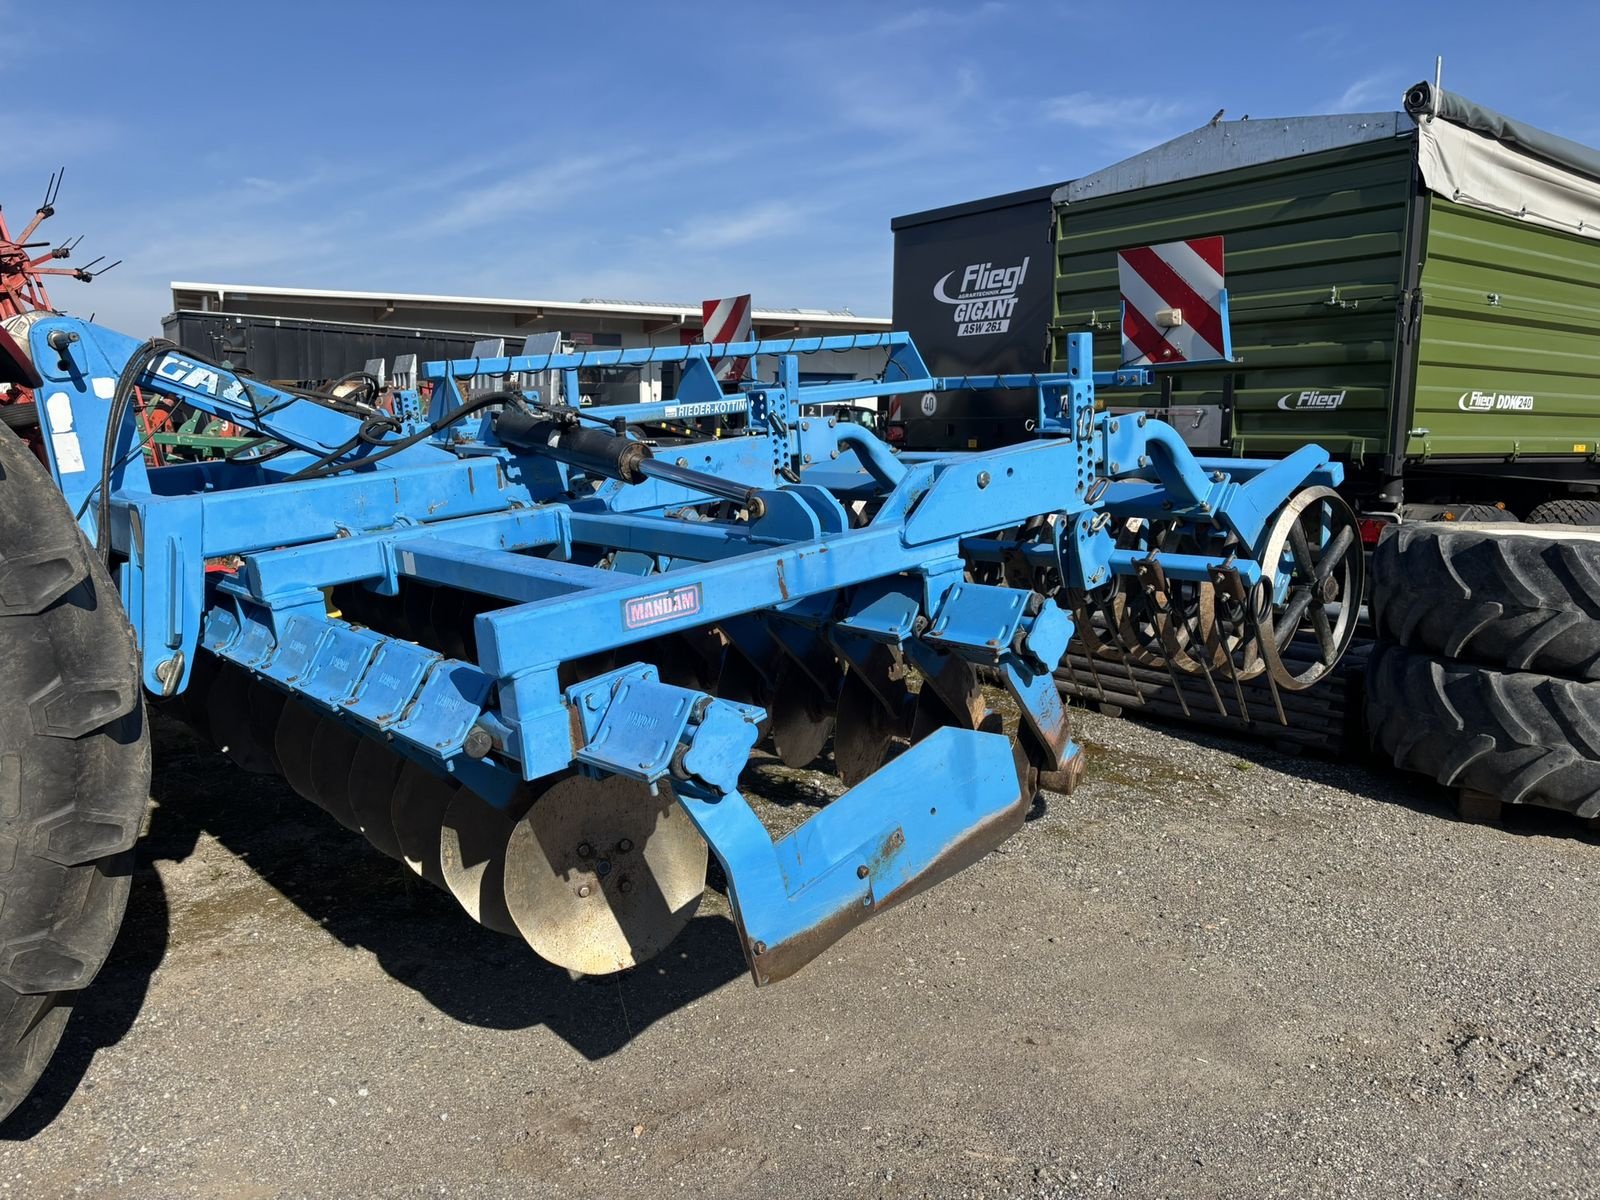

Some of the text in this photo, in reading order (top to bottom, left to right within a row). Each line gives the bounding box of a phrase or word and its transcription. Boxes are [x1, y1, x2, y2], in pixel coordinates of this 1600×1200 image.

[960, 256, 1030, 294] Fliegl
[953, 297, 1019, 323] GIGANT
[962, 320, 1002, 335] ASW 261
[922, 396, 936, 412] 40
[1296, 390, 1347, 409] Fliegl
[1468, 391, 1497, 410] Fliegl
[808, 406, 816, 416] 2
[630, 591, 695, 622] MANDAM
